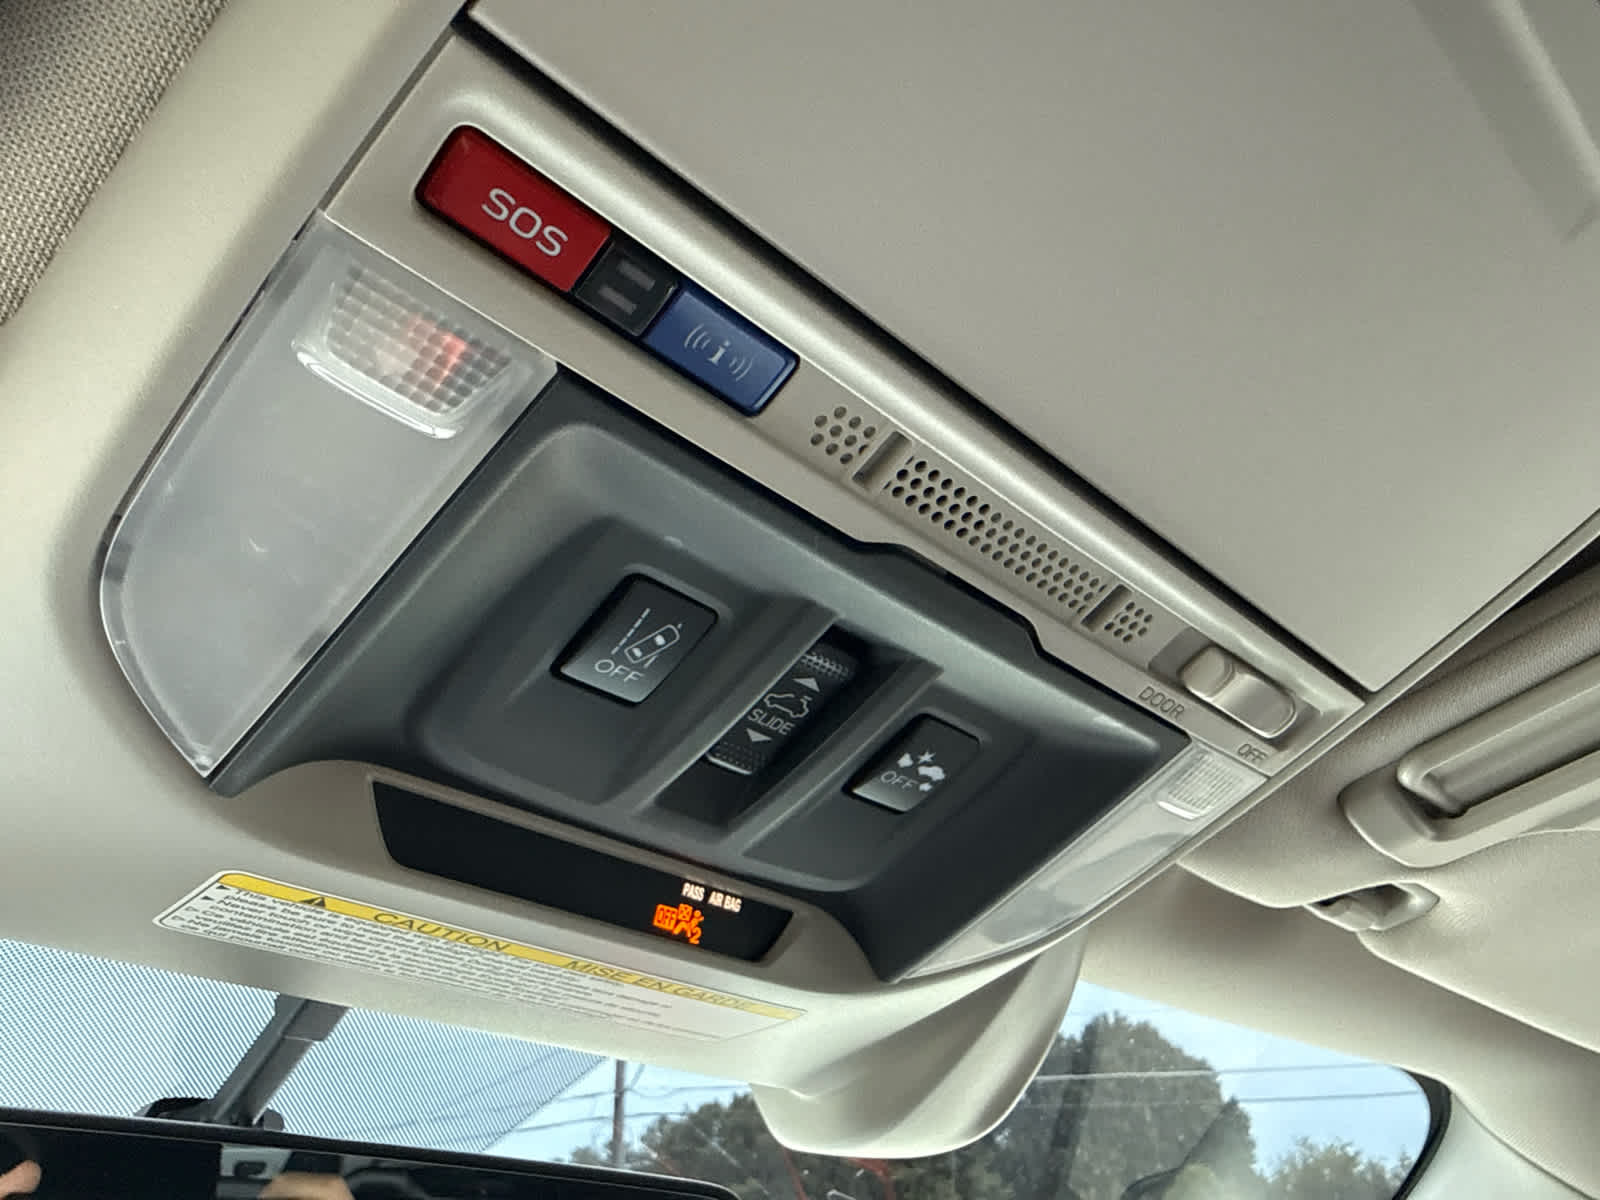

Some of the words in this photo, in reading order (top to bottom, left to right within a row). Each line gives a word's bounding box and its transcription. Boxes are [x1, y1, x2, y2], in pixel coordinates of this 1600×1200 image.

[481, 188, 569, 257] SOS
[595, 659, 645, 682] OFF
[1138, 686, 1185, 720] DOOR
[748, 708, 796, 735] SLIDE
[1238, 743, 1268, 762] OFF
[881, 770, 919, 790] OFF
[681, 882, 705, 902] PASS
[707, 890, 724, 907] AIR
[723, 895, 742, 912] BAG
[374, 912, 511, 952] CAUTION
[565, 960, 634, 981] MISE
[631, 978, 670, 993] EN
